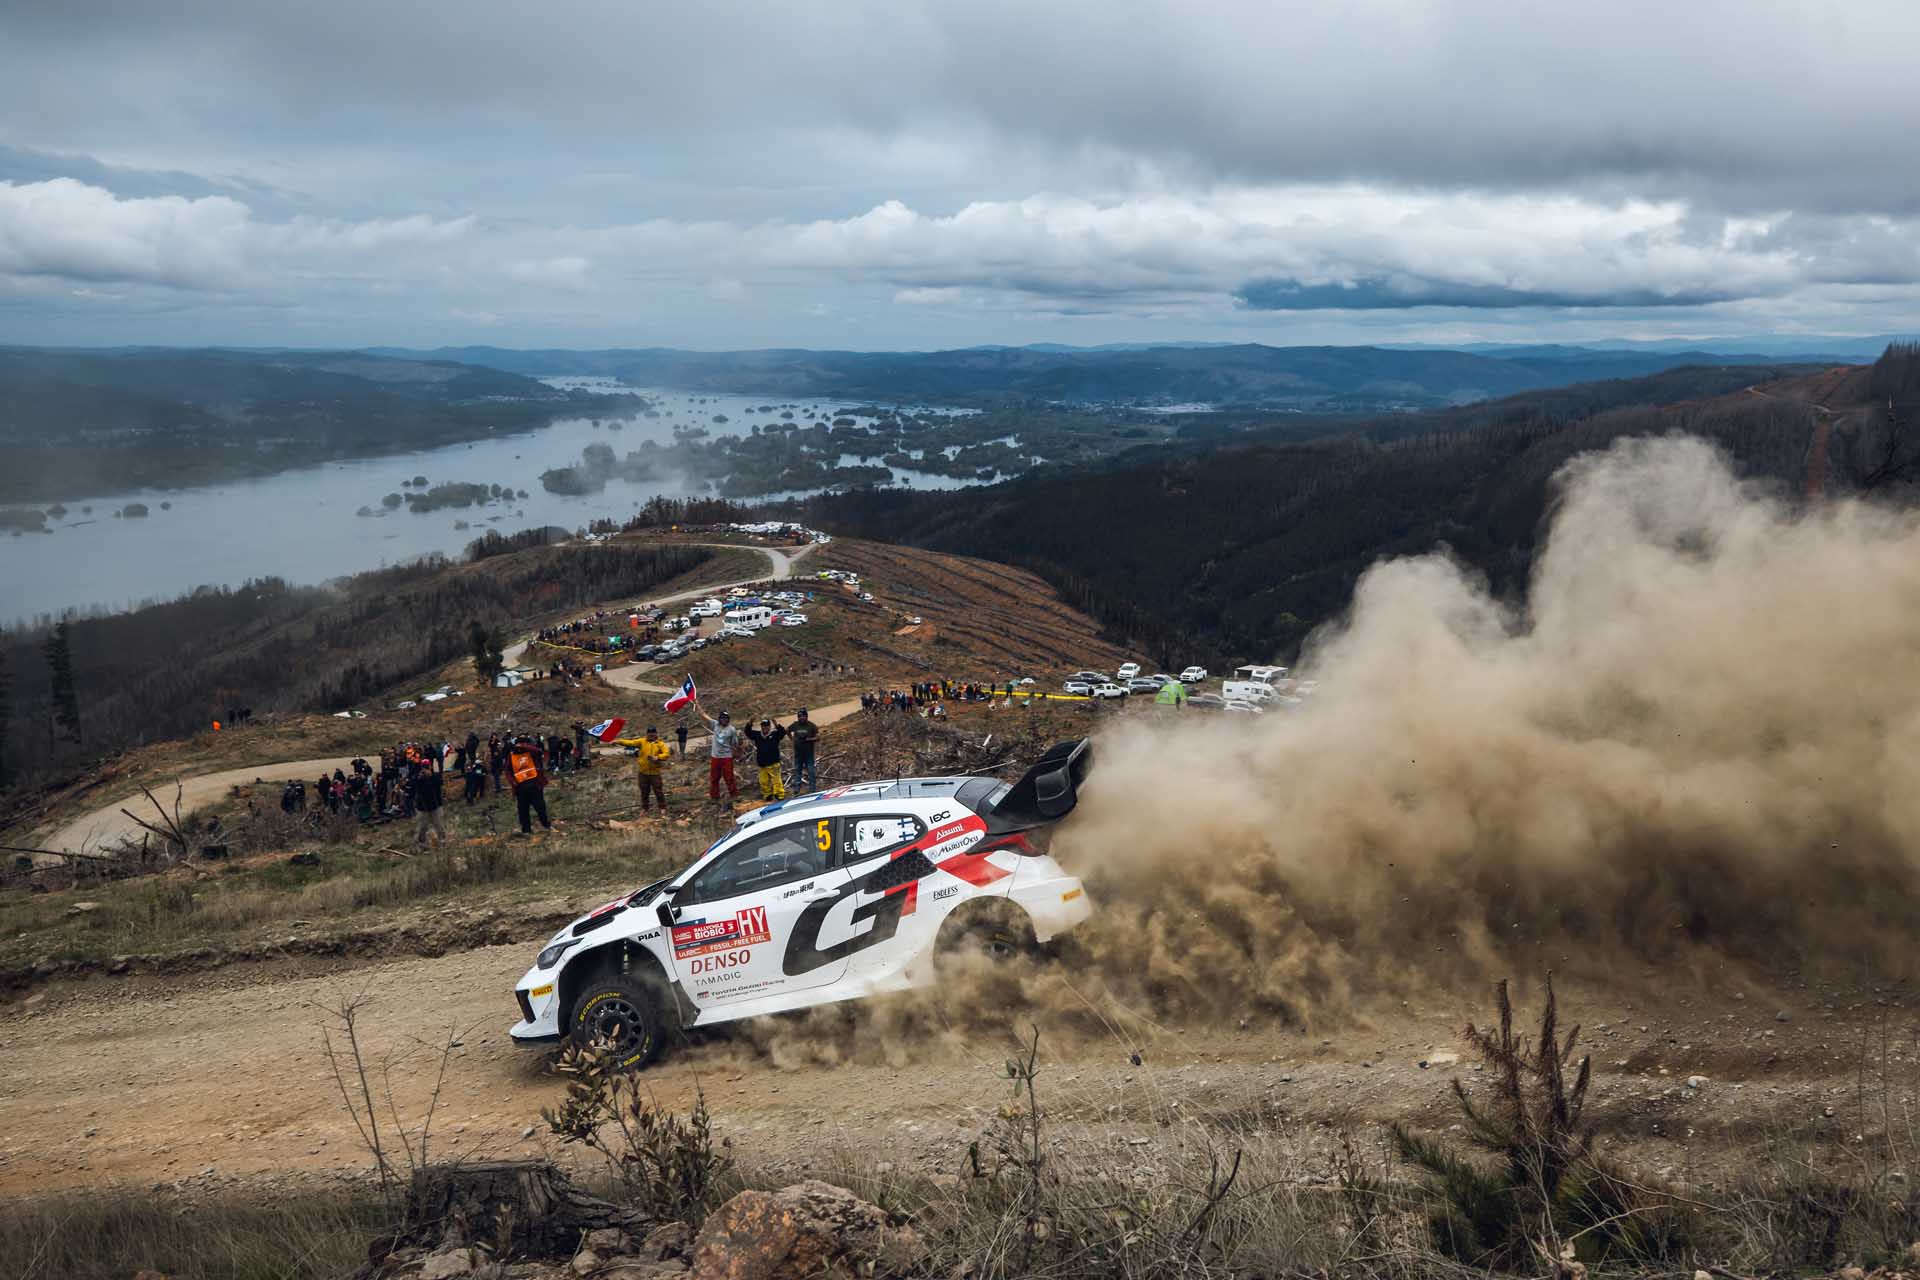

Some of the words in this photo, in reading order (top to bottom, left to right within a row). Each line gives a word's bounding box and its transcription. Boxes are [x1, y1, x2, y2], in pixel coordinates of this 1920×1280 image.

[817, 820, 832, 851] 5
[933, 886, 959, 900] ENDLESS
[738, 907, 765, 937] HY
[637, 931, 661, 941] PIAA
[691, 949, 751, 975] DENSO
[695, 971, 742, 986] TAMADIC
